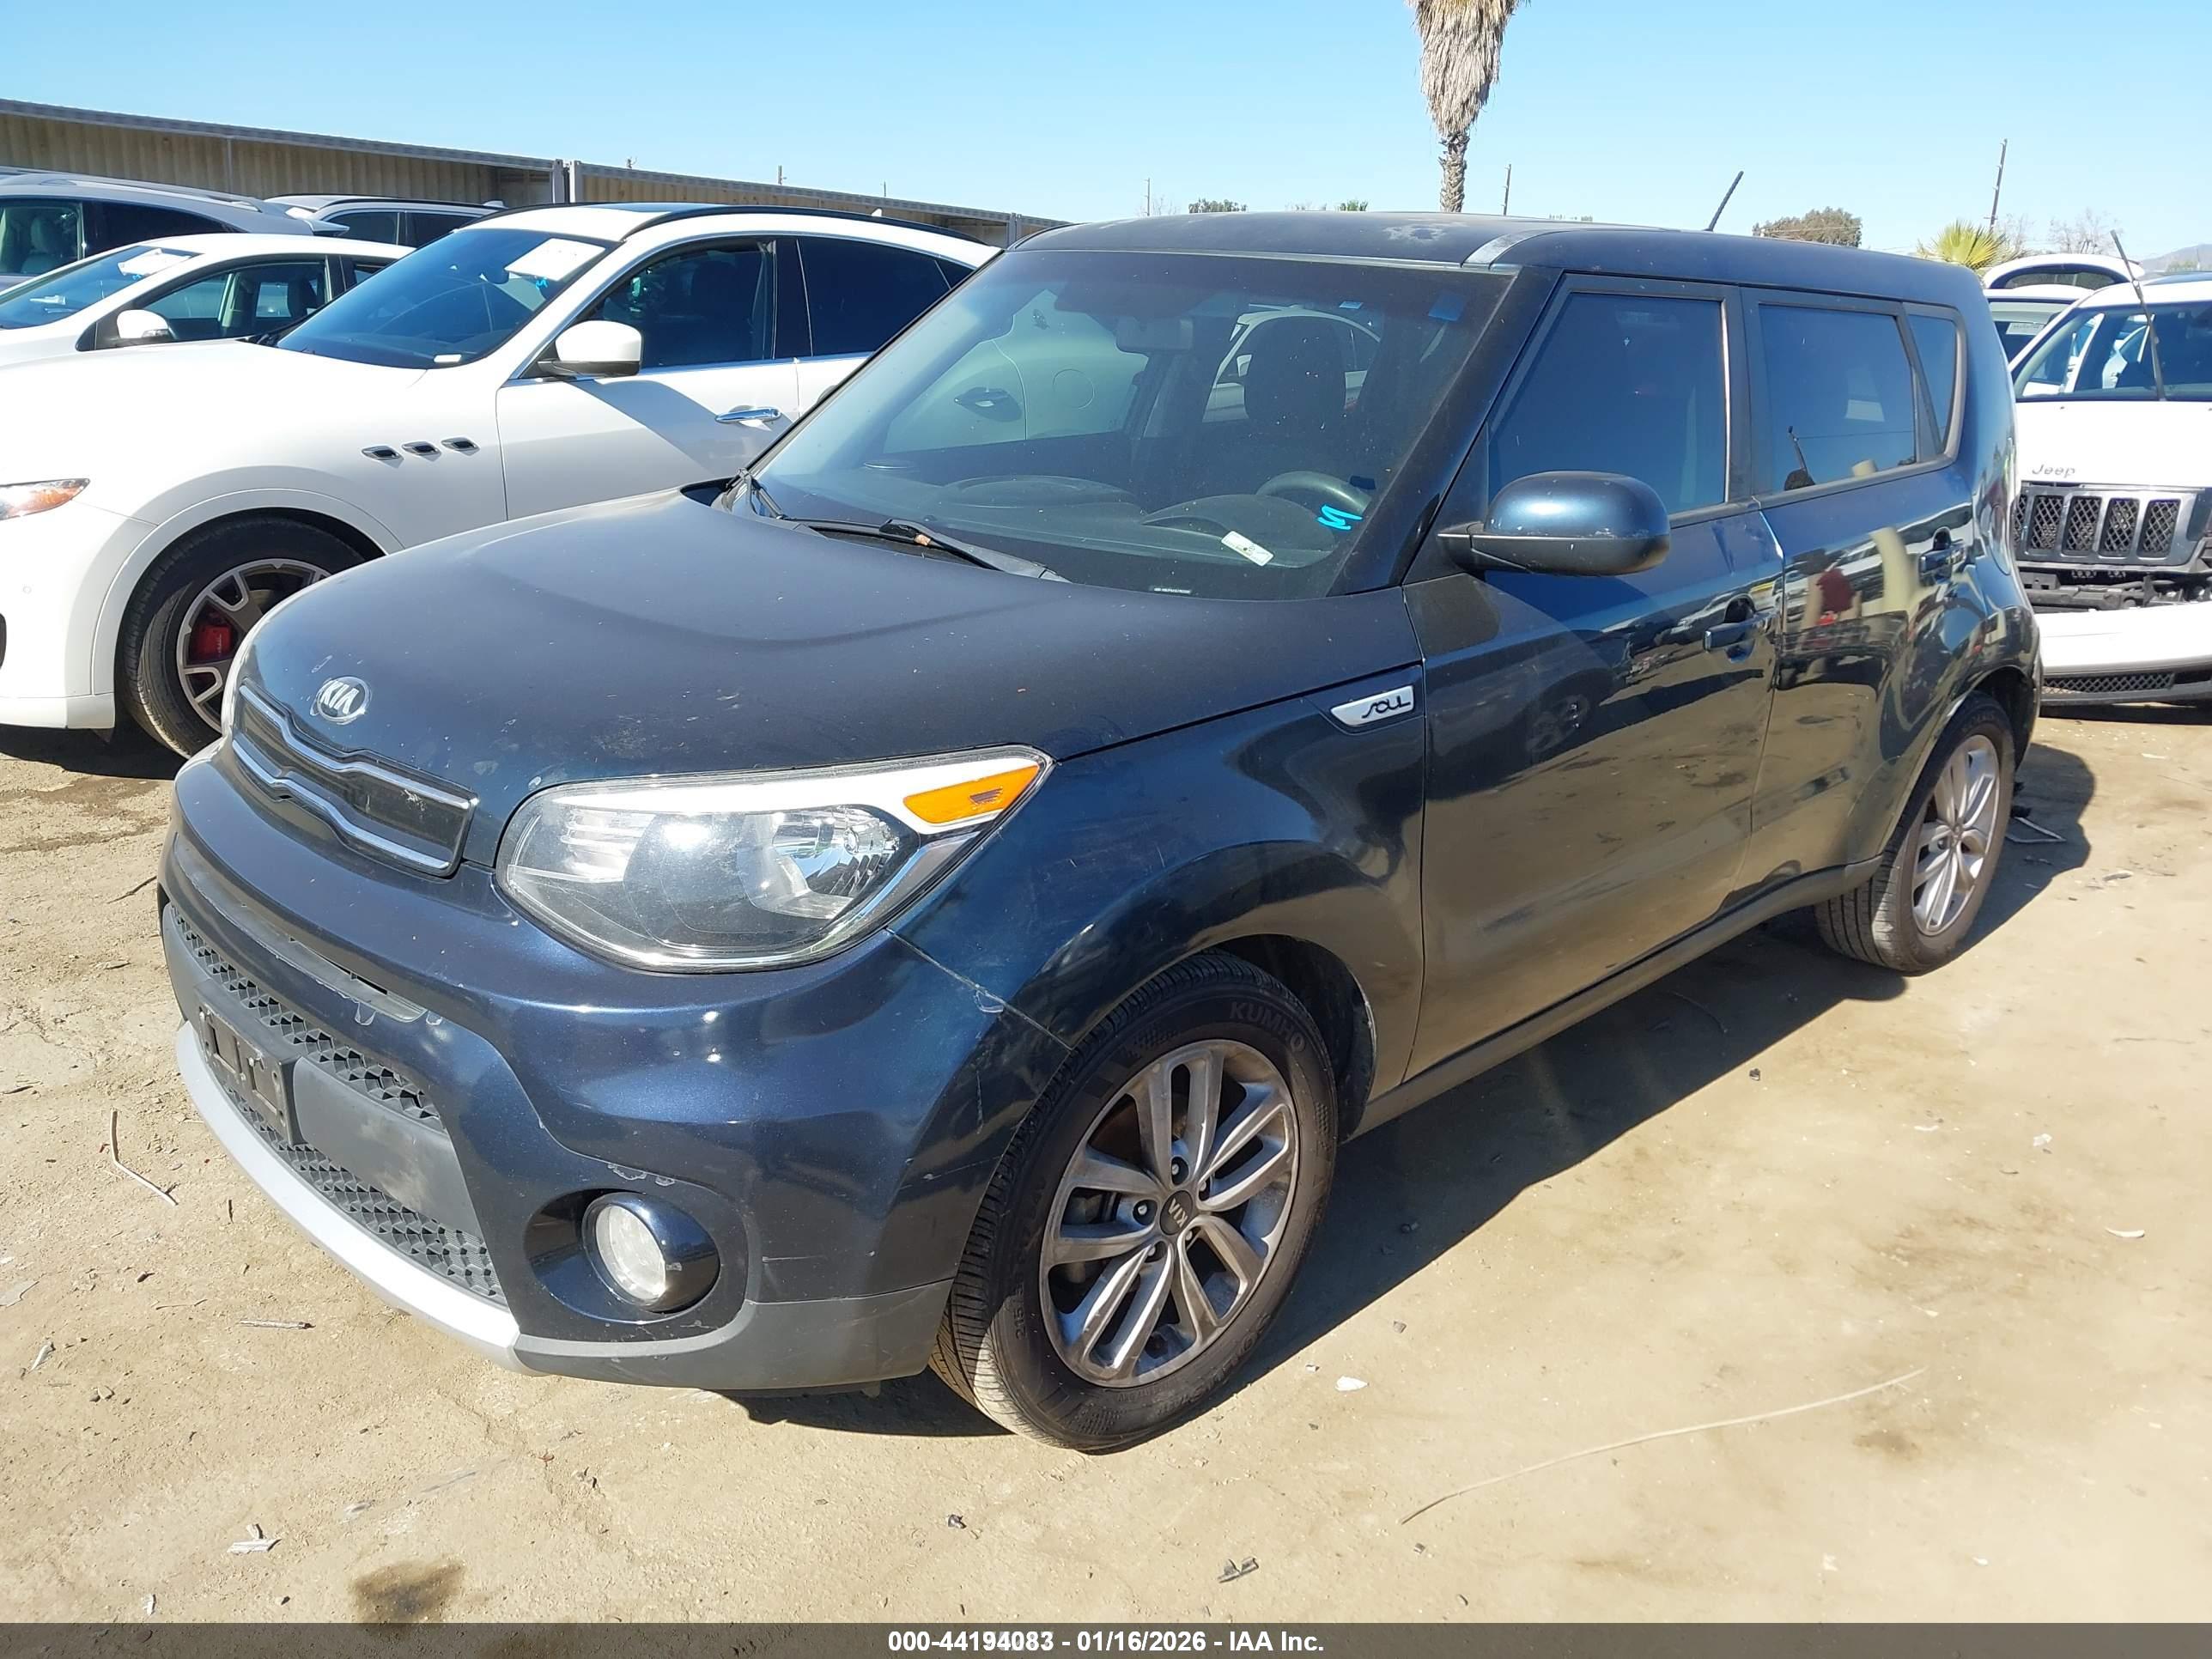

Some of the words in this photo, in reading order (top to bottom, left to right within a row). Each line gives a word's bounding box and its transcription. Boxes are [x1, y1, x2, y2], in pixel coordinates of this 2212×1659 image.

[2032, 464, 2075, 478] Jeep
[319, 679, 360, 715] KIA
[1229, 1001, 1306, 1052] KUMHO
[1168, 1197, 1188, 1228] KIA
